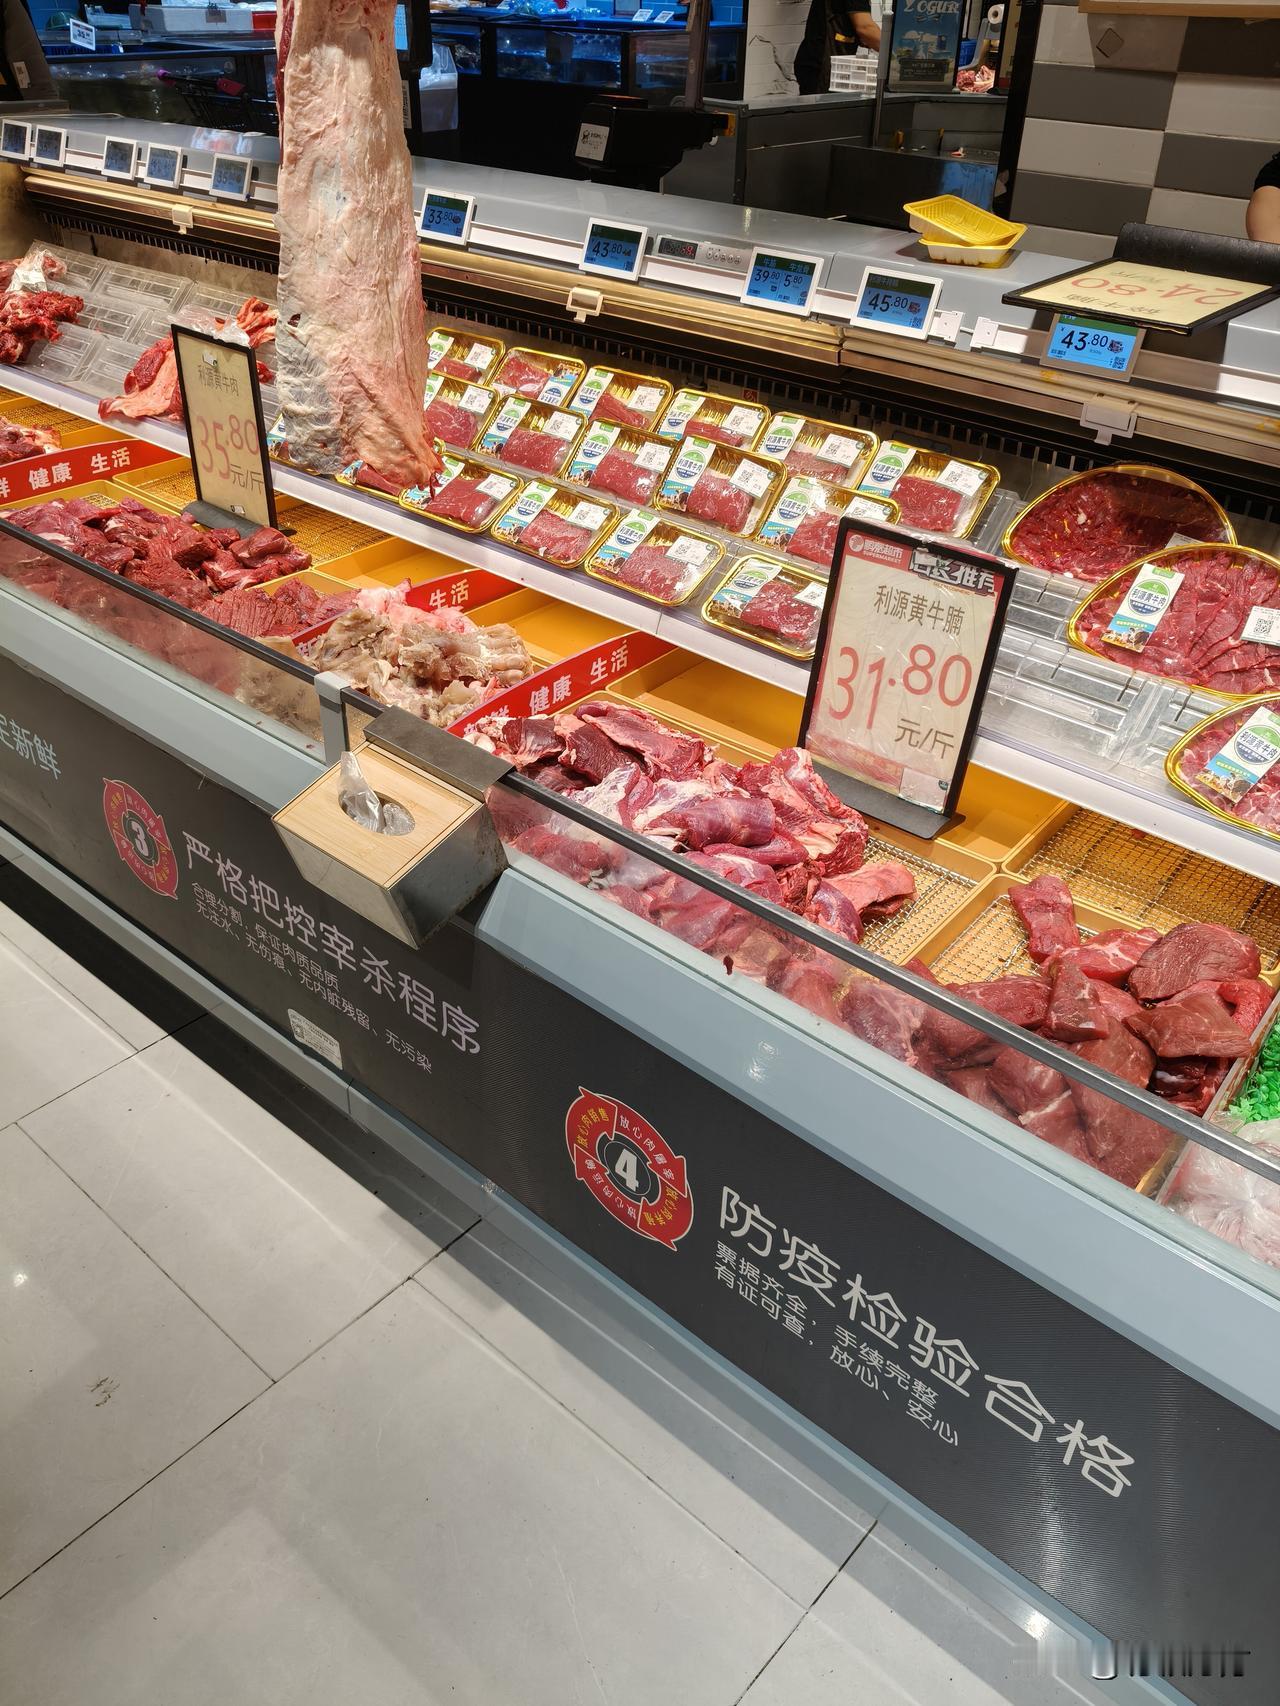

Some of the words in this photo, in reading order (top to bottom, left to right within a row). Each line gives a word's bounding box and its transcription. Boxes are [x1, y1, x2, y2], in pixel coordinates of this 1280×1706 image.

[1071, 276, 1245, 305] 24.80
[28, 462, 73, 491] 健康
[90, 446, 131, 474] 生活
[197, 414, 259, 480] 35.80
[230, 463, 265, 494] 元/斤
[429, 579, 470, 610] 生活
[873, 584, 965, 637] 利源黄牛腩
[529, 674, 572, 716] 健康
[590, 639, 629, 686] 生活
[828, 643, 973, 730] 31.80
[894, 717, 955, 760] 元/斤
[131, 820, 149, 857] 3
[182, 831, 481, 1054] 严格把控宰杀程序
[614, 1148, 640, 1192] 4
[716, 1240, 939, 1409] 票据齐全，手续完整
[719, 1185, 1136, 1498] 防疫检验合格
[714, 1262, 959, 1446] 有证可查，放心、安心
